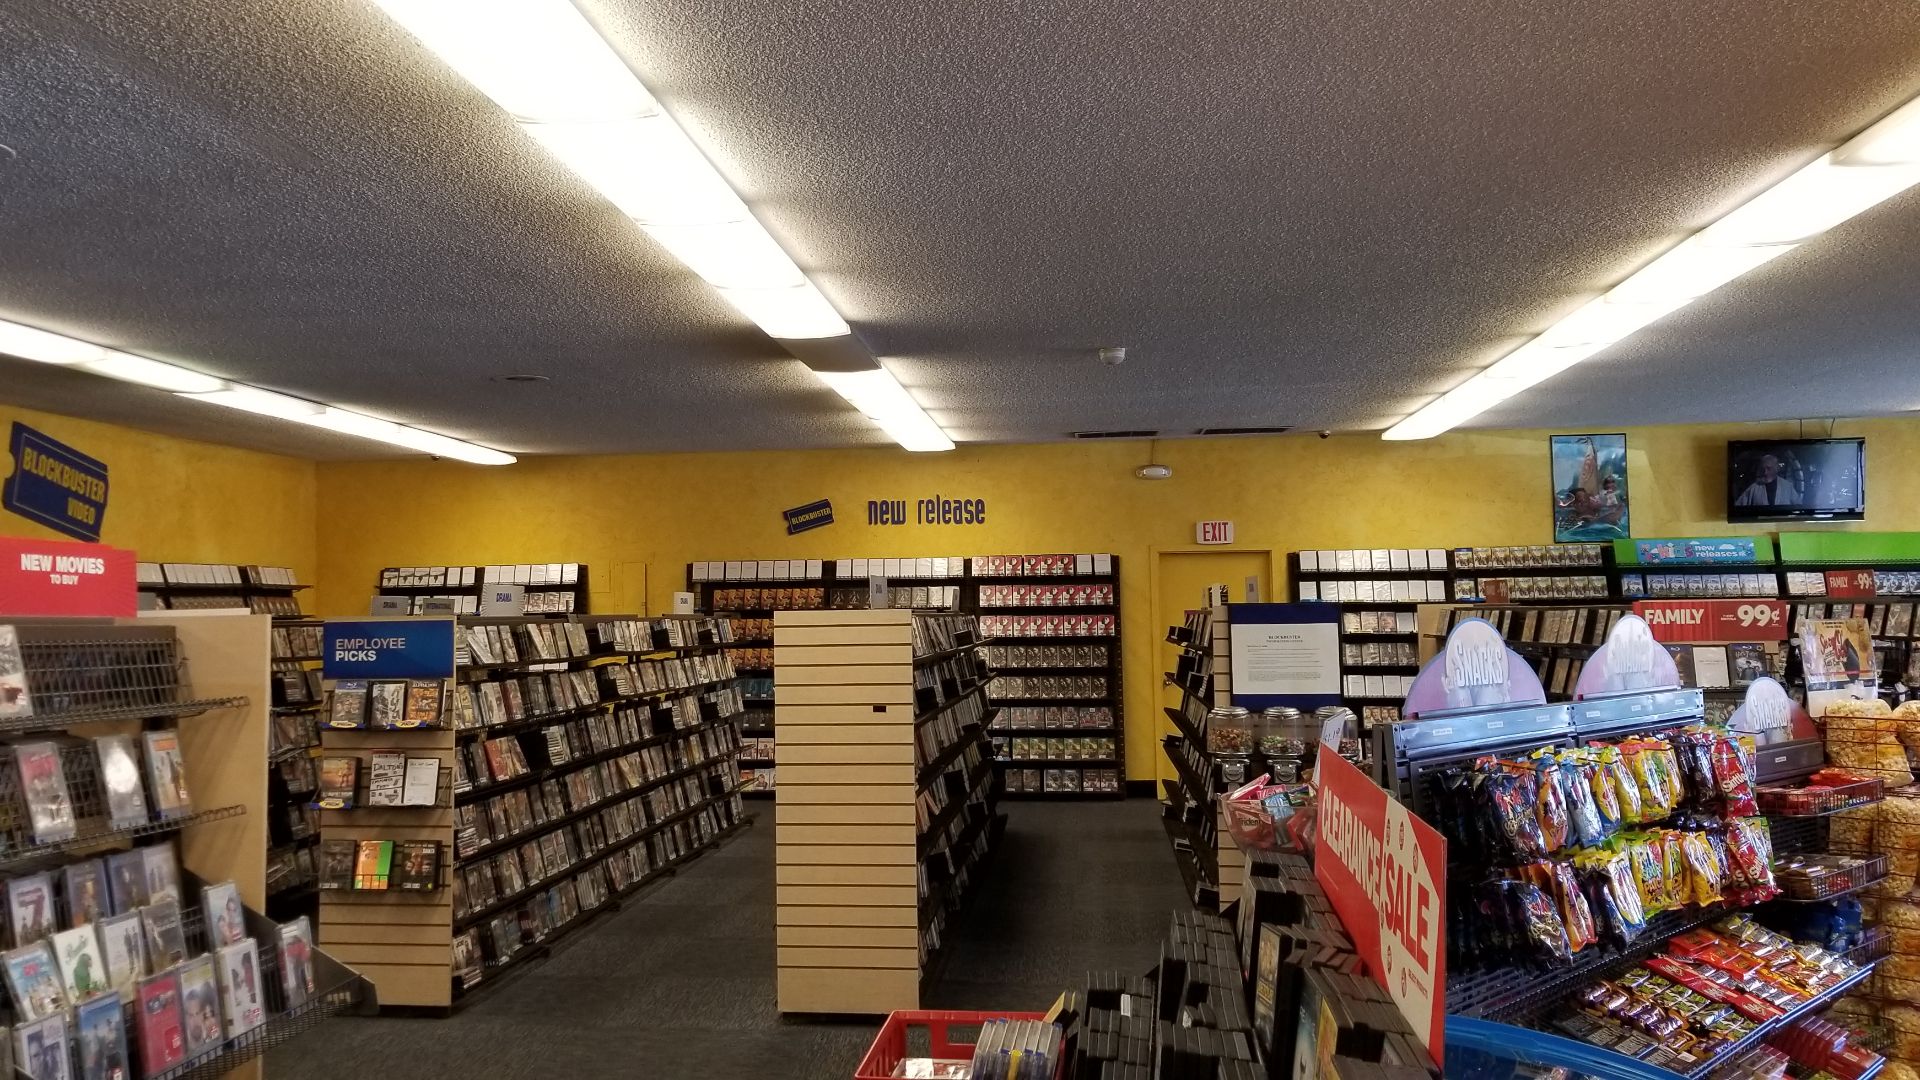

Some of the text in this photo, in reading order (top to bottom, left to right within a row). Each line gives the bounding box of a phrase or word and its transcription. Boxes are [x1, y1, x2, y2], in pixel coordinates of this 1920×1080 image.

[23, 447, 105, 503] BLOCKBUSTER
[67, 497, 96, 525] VIDEO
[791, 507, 832, 526] BLOCKBUSTER
[867, 494, 985, 525] new release
[1202, 522, 1229, 542] EXIT
[20, 553, 104, 575] NEW MOVIES
[50, 574, 79, 585] TO BUY
[1830, 576, 1848, 588] FAMILY
[1644, 608, 1704, 625] FAMILY
[335, 637, 406, 650] EMPLOYEE
[335, 651, 377, 662] PICKS
[1321, 785, 1382, 910] CLEARANCE
[1385, 852, 1430, 975] SALE
